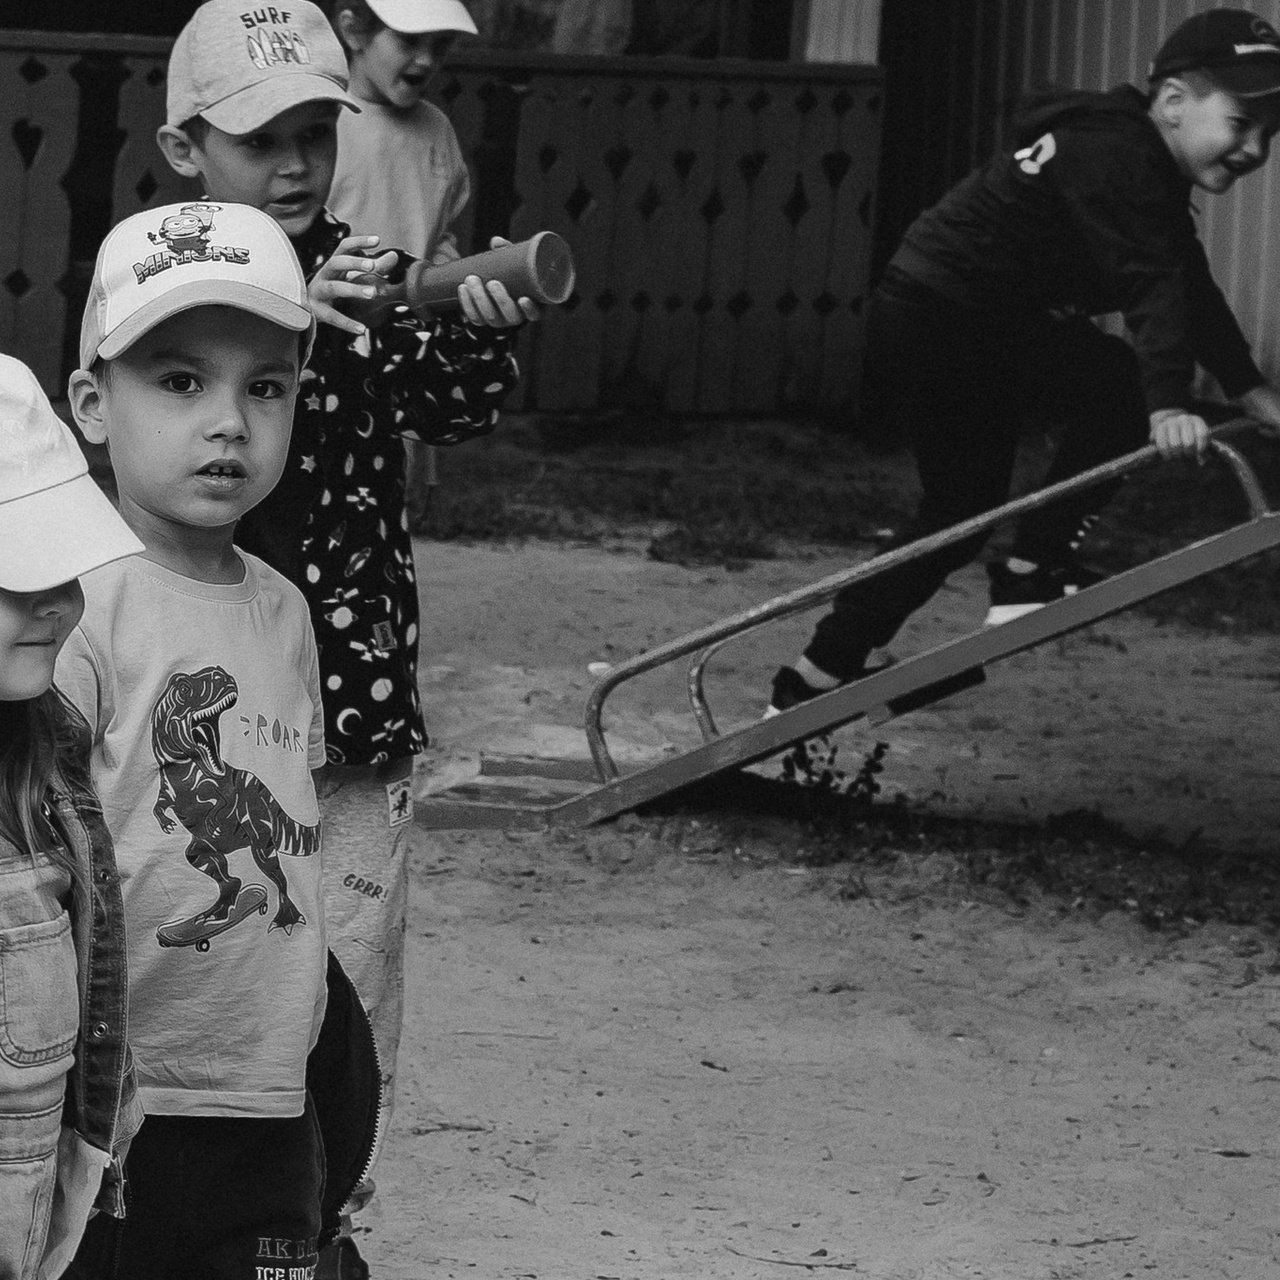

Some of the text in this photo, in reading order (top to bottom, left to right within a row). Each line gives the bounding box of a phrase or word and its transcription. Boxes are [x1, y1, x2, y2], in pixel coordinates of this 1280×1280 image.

[240, 7, 291, 29] SURF
[132, 246, 250, 284] MINIONS
[256, 713, 304, 753] ROAR
[343, 873, 389, 904] GRRR!
[256, 1237, 293, 1259] AK
